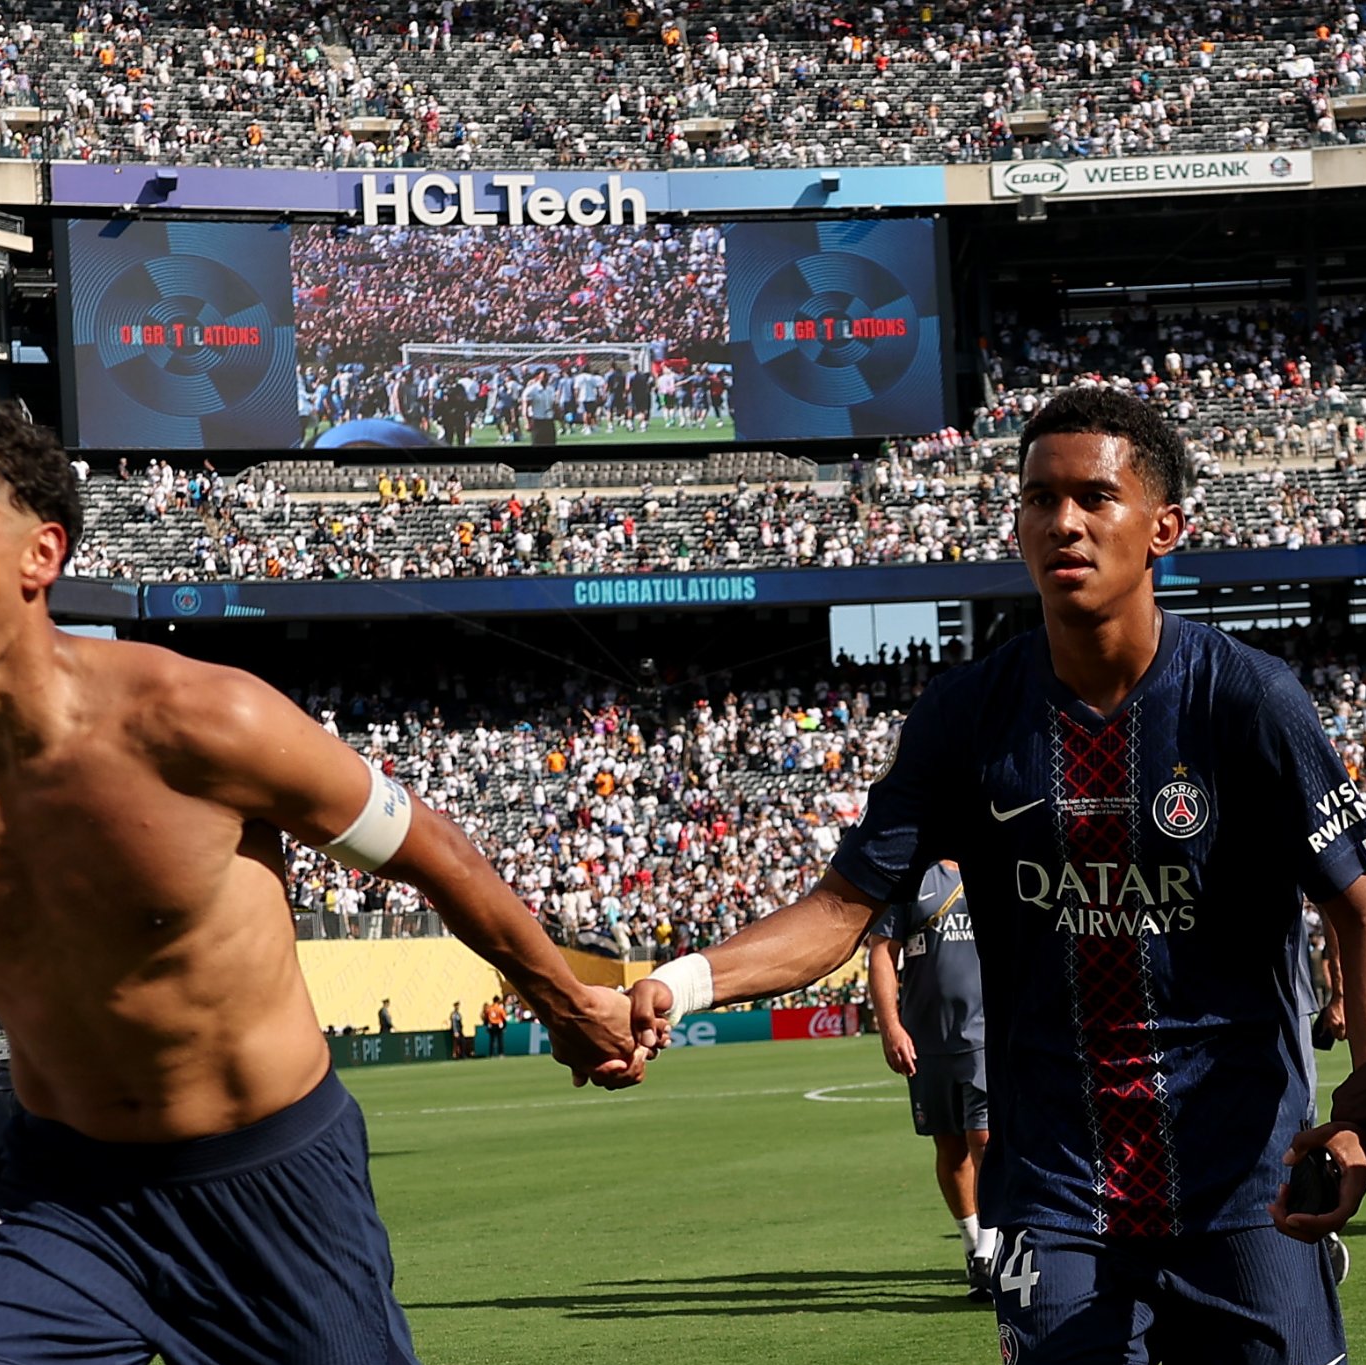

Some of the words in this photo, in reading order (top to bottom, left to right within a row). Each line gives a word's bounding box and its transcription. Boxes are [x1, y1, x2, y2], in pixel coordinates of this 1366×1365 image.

[1011, 171, 1061, 185] COACH
[1084, 166, 1149, 183] WEEB
[1154, 160, 1249, 182] EWBANK
[362, 174, 647, 227] HCLTech
[574, 576, 756, 605] CONGRATULATIONS
[1162, 785, 1199, 799] PARIS
[1016, 860, 1195, 910] QATAR
[1055, 905, 1196, 937] AIRWAYS
[363, 1038, 382, 1061] PIF
[415, 1035, 434, 1057] PIF
